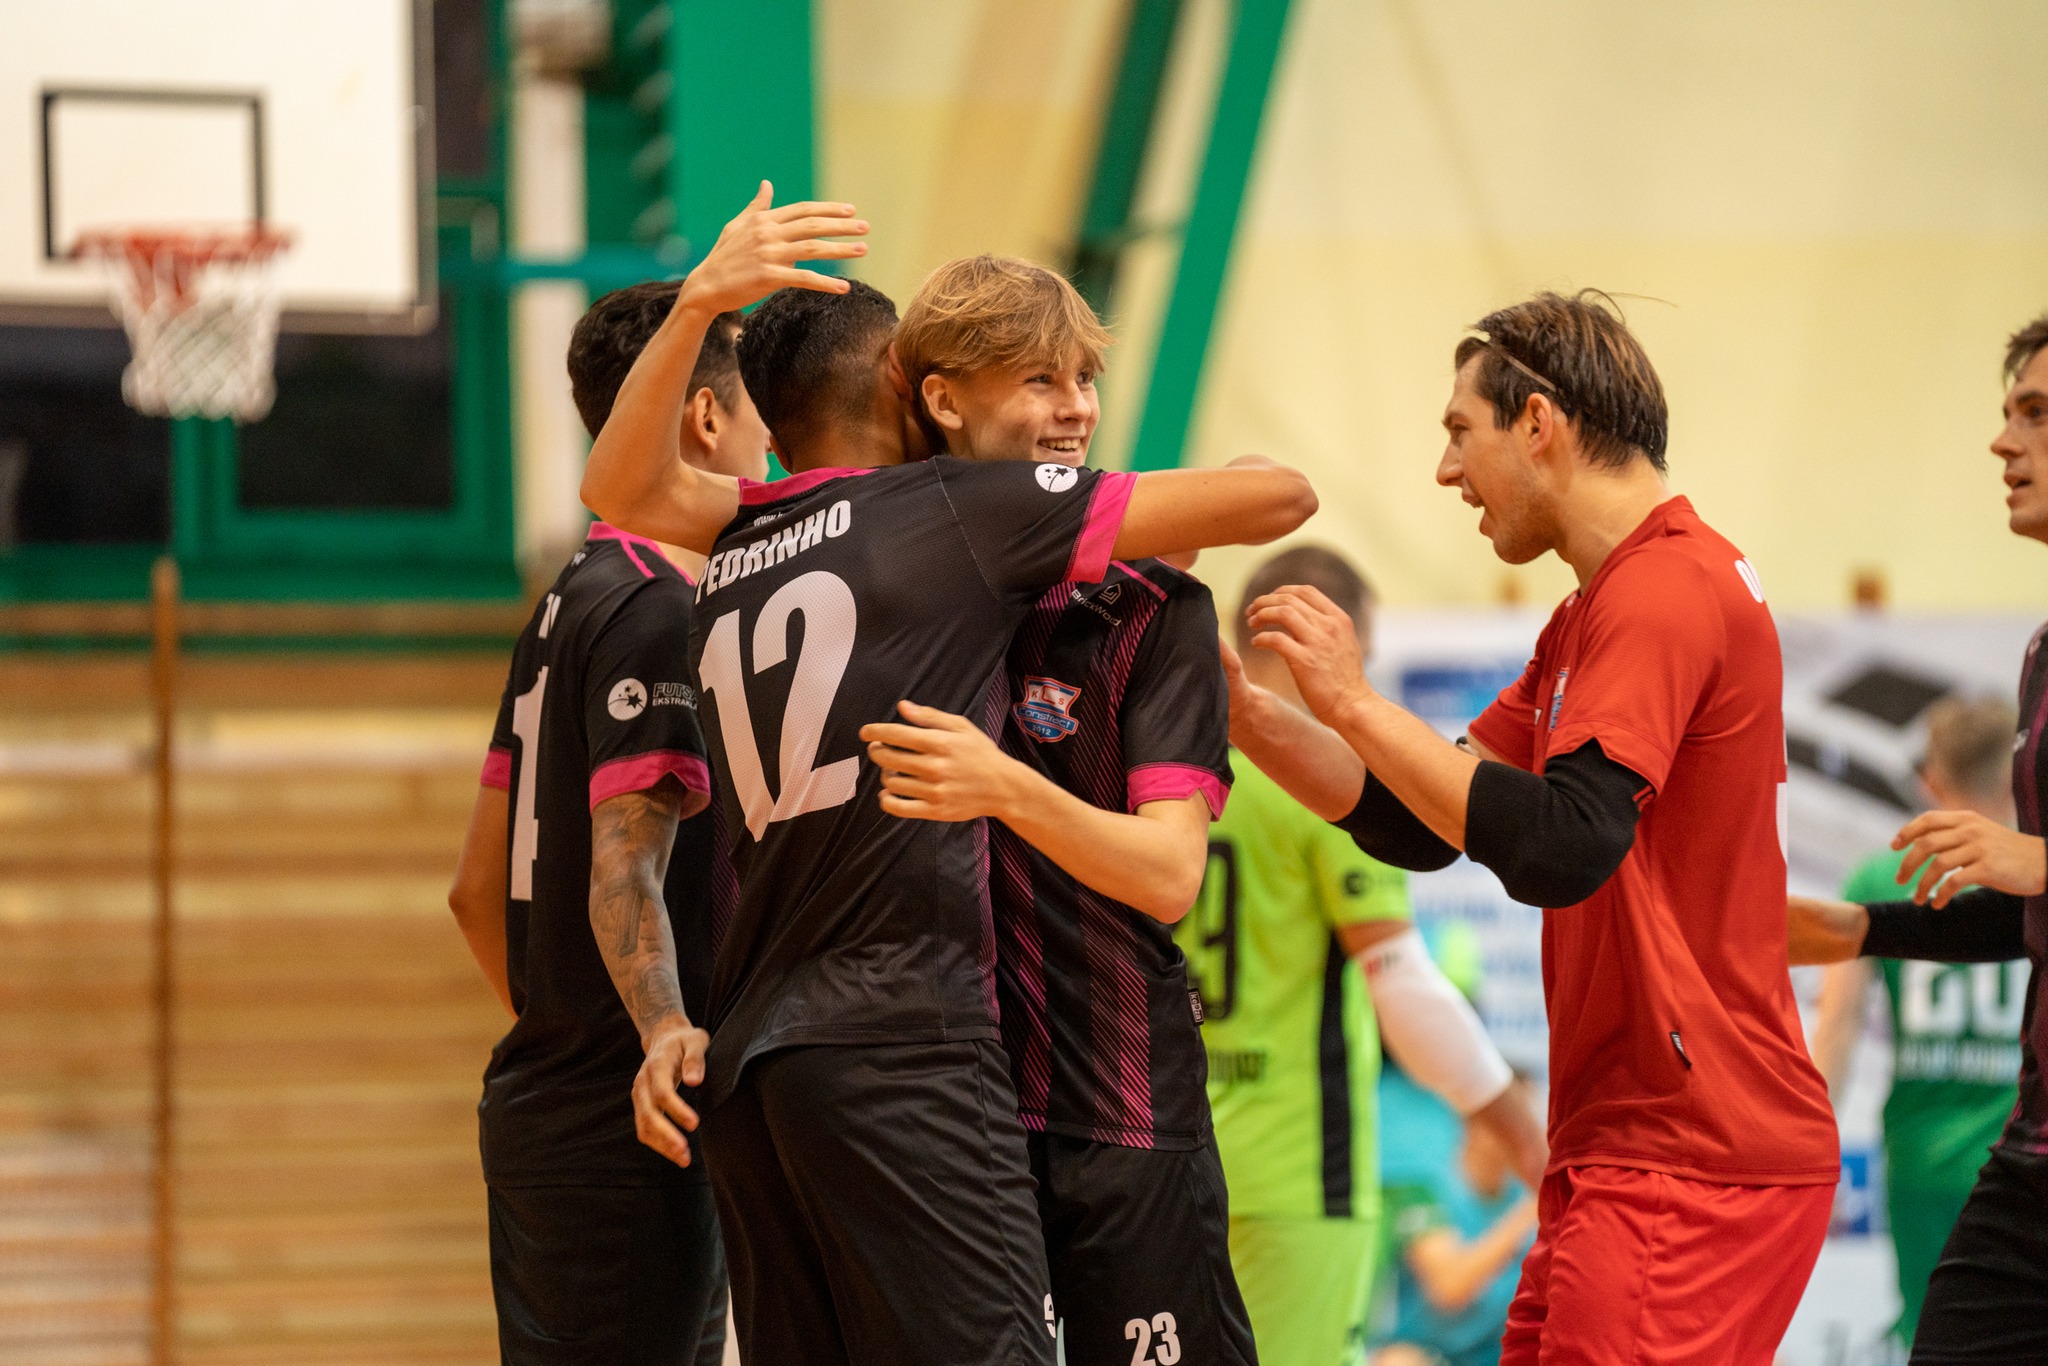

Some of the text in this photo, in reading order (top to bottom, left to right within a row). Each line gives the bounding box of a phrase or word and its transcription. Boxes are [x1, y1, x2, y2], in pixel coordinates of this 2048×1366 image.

[695, 499, 851, 606] PEDRINHO
[698, 570, 860, 843] 12
[1020, 707, 1071, 729] Constract
[1032, 724, 1052, 736] 2012
[1124, 1311, 1181, 1366] 23
